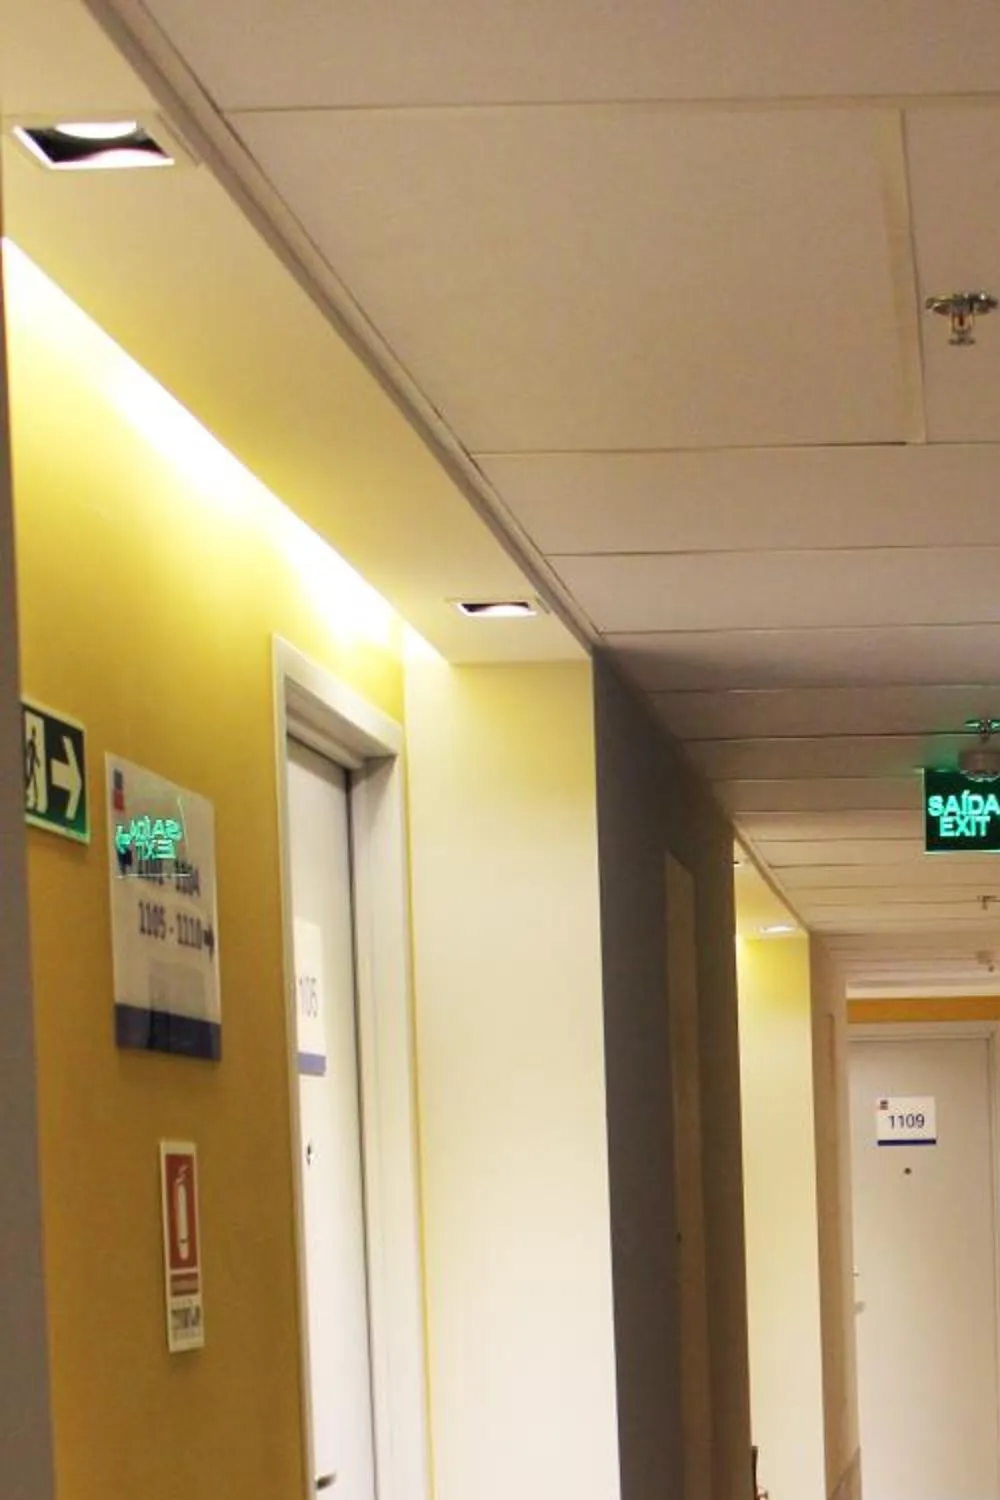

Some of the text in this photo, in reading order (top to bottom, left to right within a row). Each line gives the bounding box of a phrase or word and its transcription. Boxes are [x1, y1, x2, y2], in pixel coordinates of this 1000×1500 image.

[928, 789, 1000, 817] SAÍDA
[939, 816, 991, 837] EXIT
[888, 1113, 925, 1129] 1109
